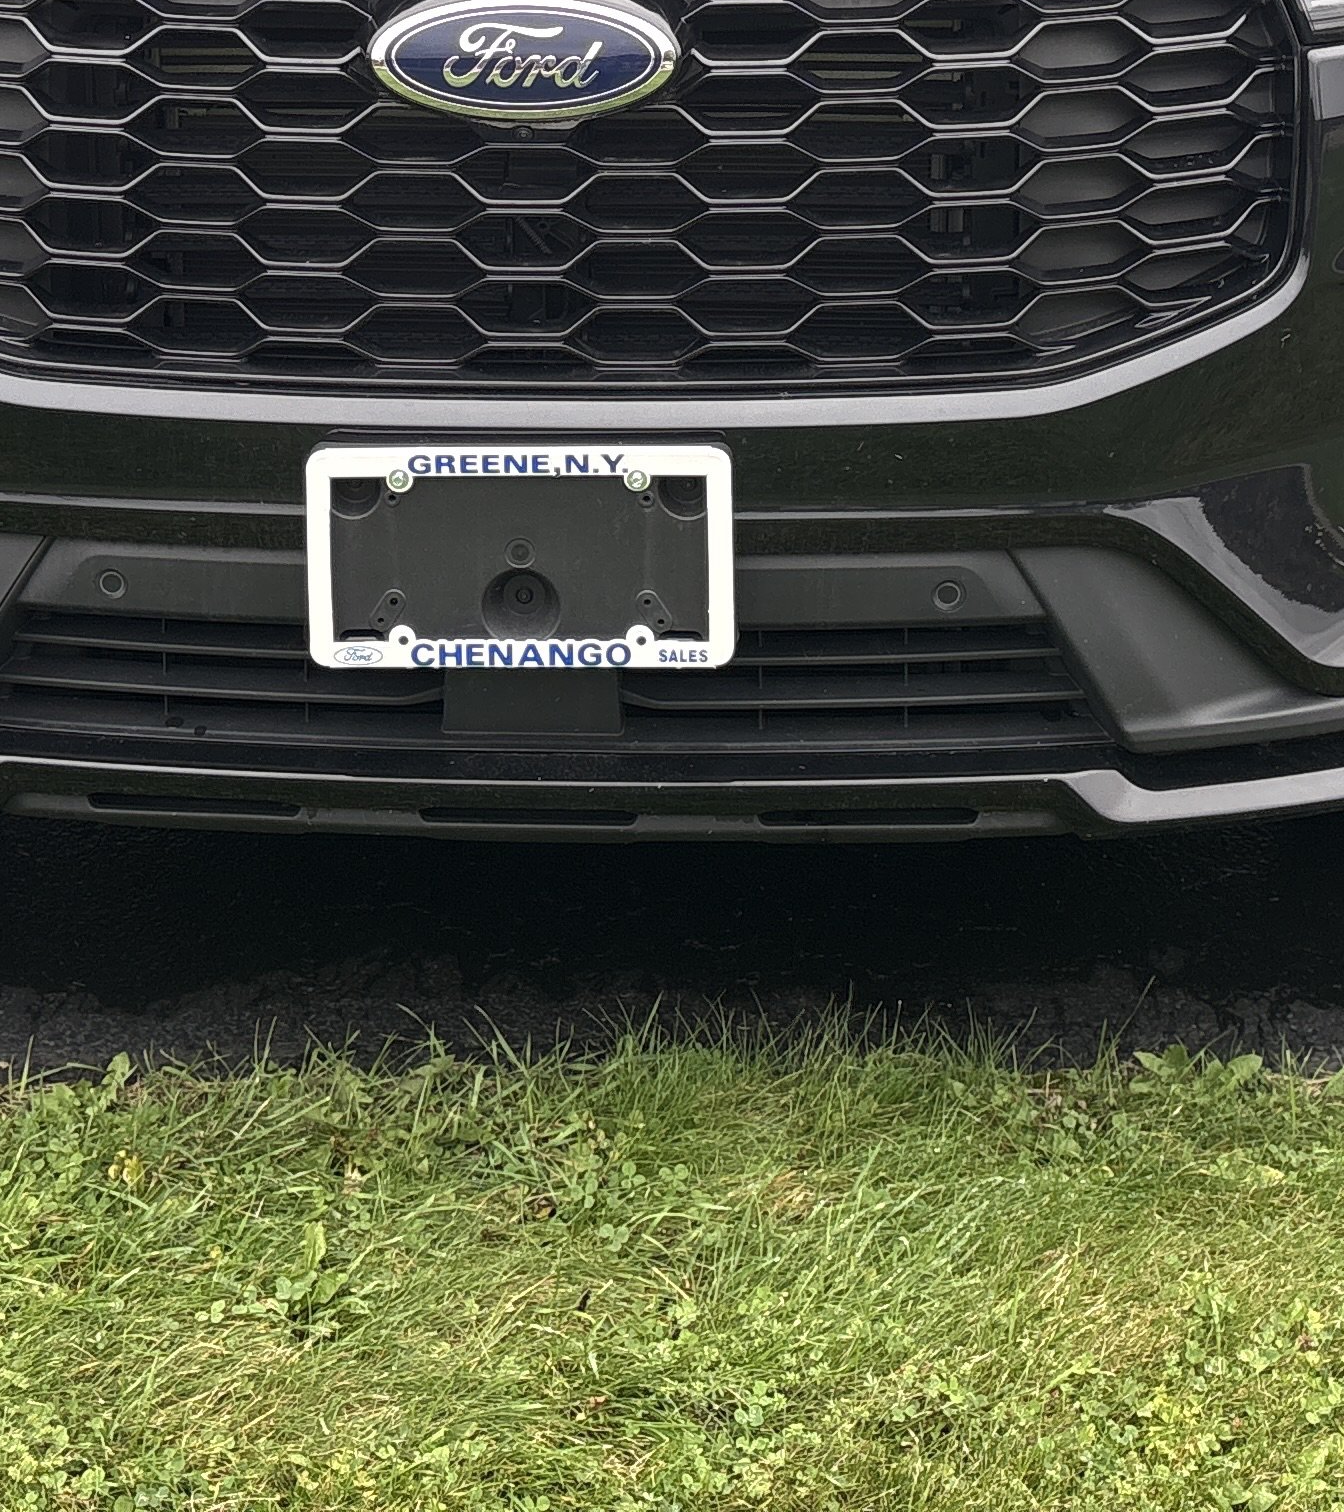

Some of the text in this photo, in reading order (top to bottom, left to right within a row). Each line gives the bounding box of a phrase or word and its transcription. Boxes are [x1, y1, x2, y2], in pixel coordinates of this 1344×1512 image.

[443, 22, 604, 89] Ford
[411, 642, 632, 667] CHENANGO
[657, 648, 709, 664] SALES
